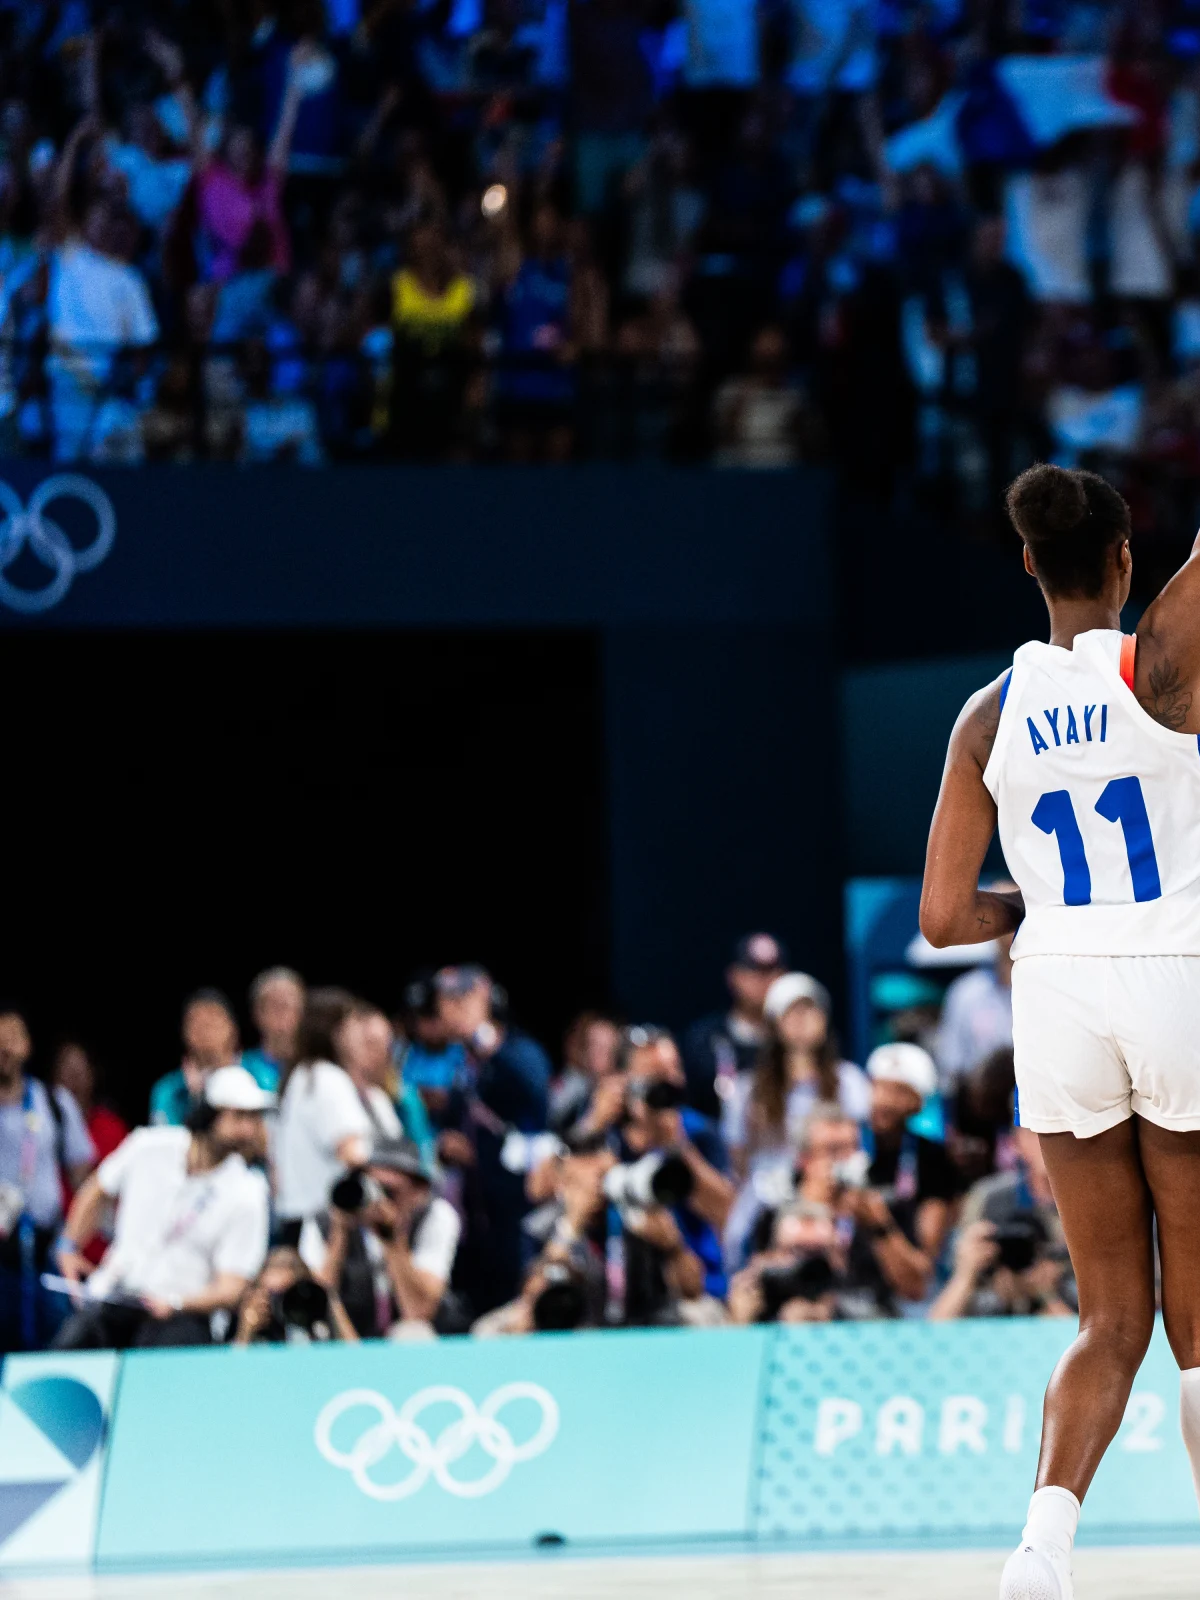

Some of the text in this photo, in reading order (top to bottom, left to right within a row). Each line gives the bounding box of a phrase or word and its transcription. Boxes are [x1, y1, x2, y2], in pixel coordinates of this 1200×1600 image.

[1026, 704, 1108, 756] AYAYI
[1030, 775, 1163, 907] 11
[813, 1395, 1025, 1457] PARI
